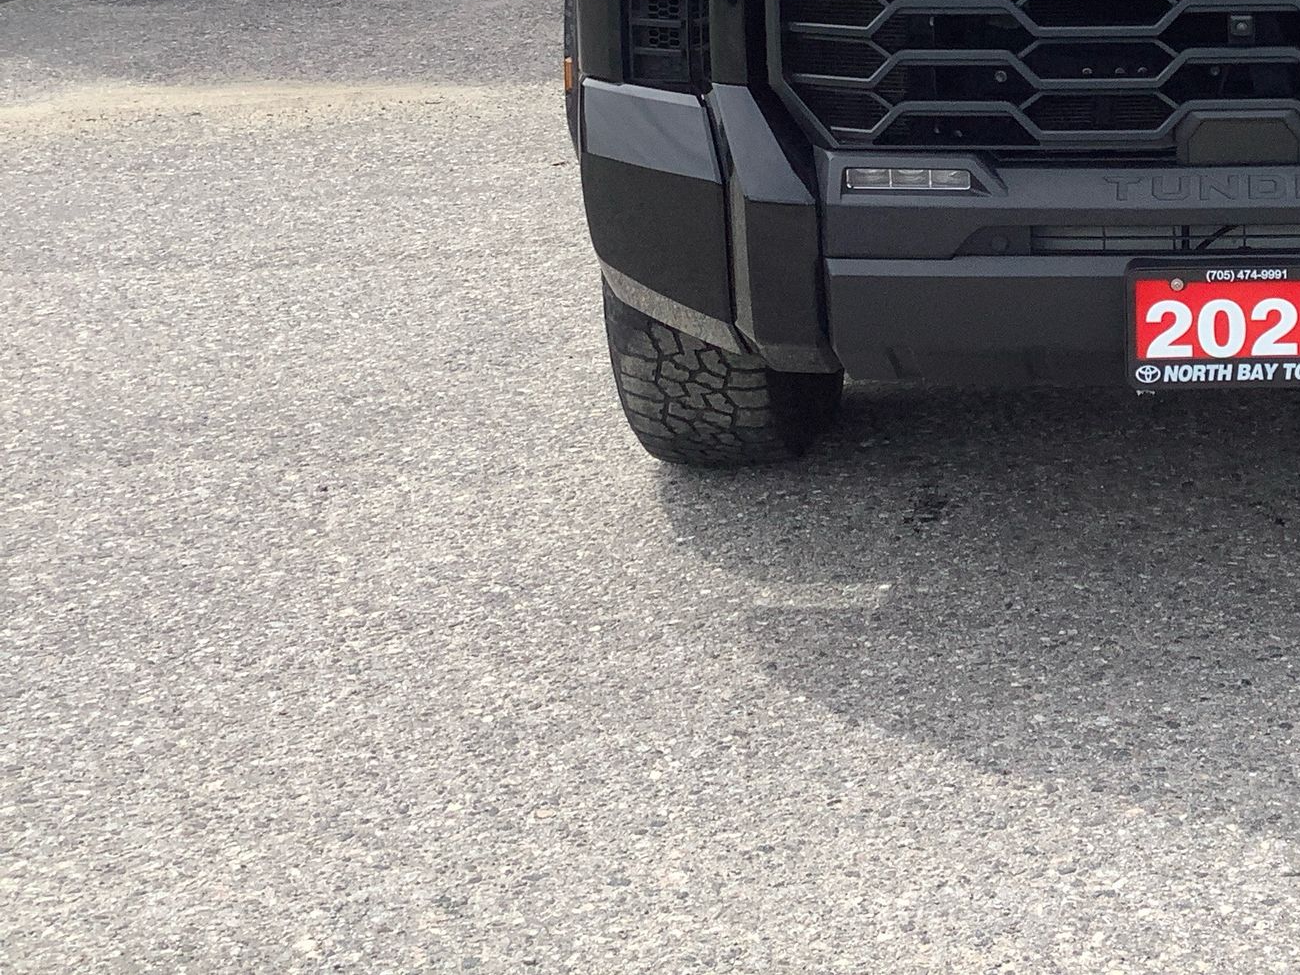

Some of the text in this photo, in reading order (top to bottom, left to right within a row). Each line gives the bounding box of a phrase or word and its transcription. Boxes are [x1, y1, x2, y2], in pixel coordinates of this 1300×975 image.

[1205, 268, 1288, 283] (705) 474-9991
[1163, 363, 1233, 383] NORTH
[1237, 363, 1280, 382] BAY
